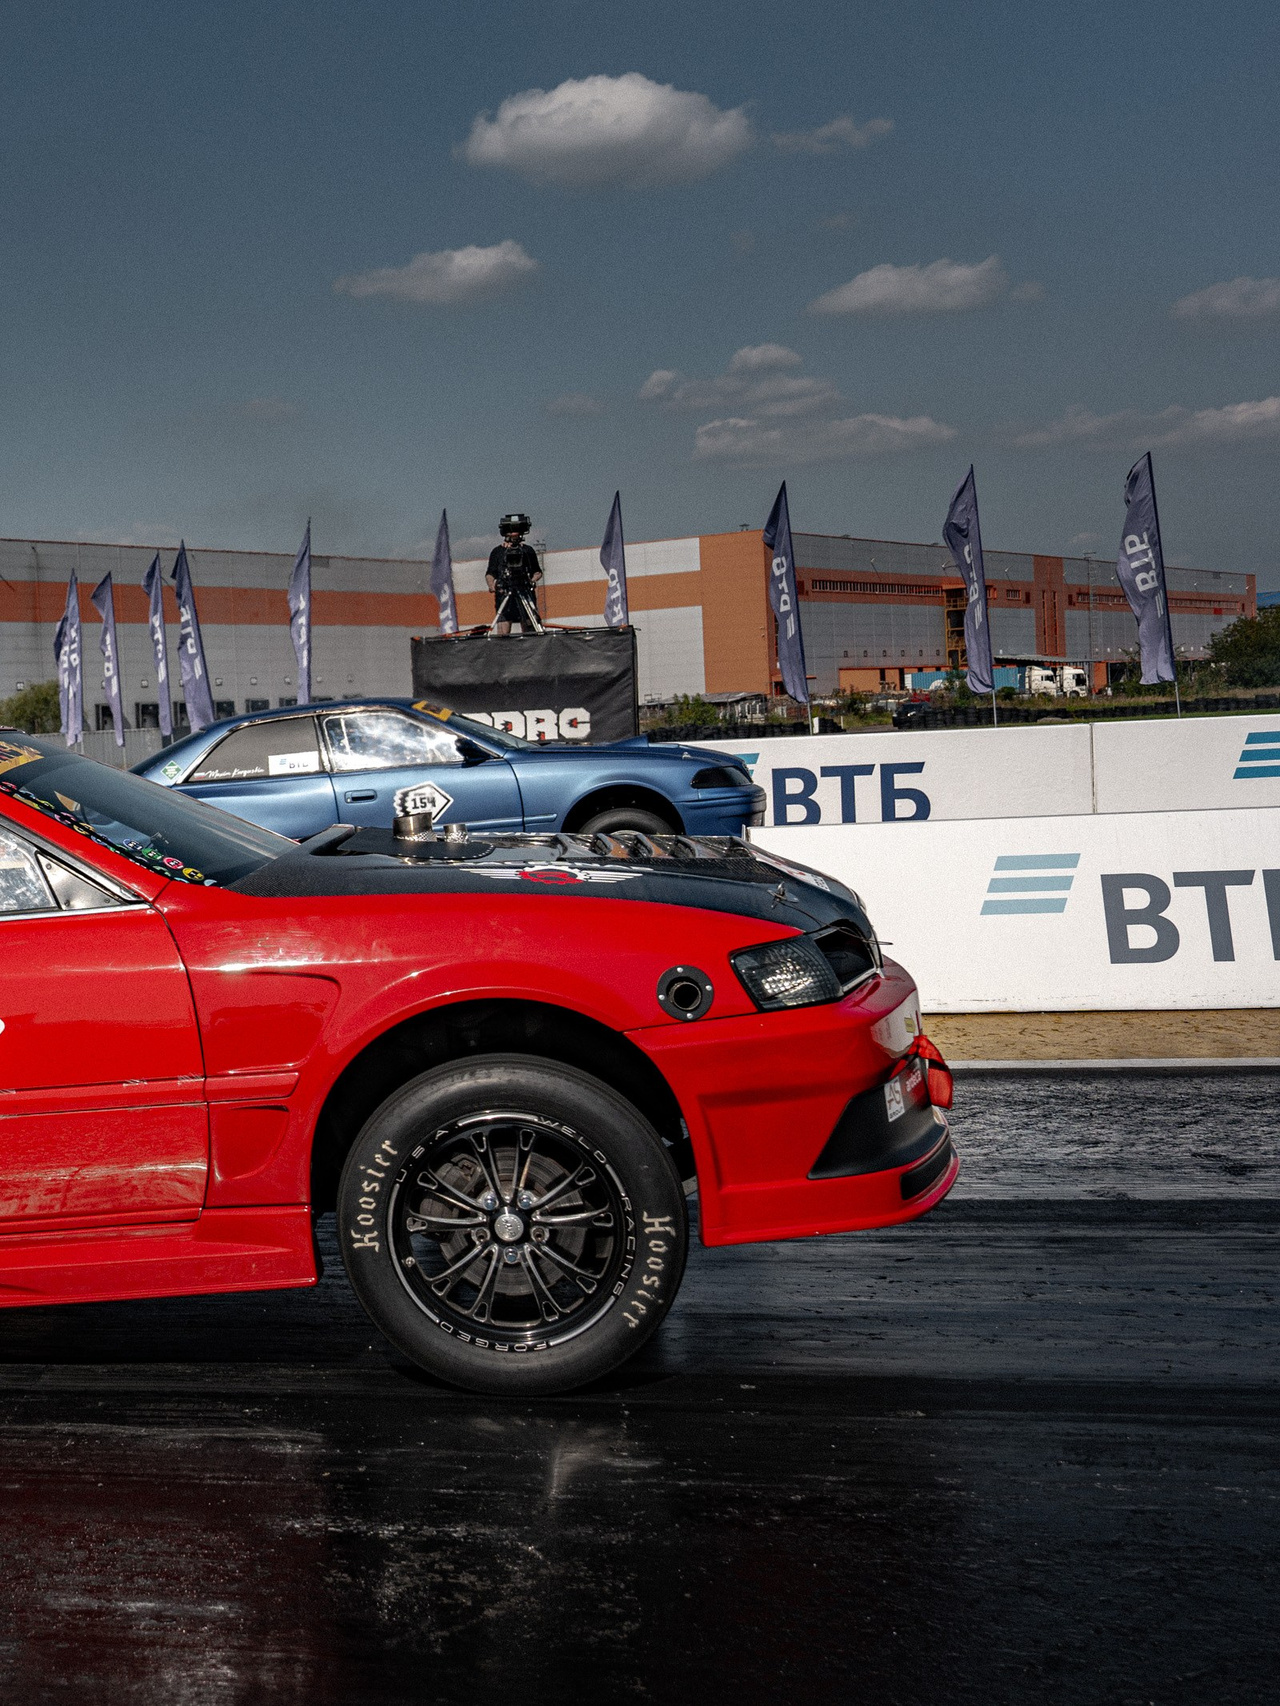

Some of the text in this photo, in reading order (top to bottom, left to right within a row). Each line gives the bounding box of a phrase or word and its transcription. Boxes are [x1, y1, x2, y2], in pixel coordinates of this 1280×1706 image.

[461, 707, 591, 741] DRC
[771, 761, 931, 825] ВТБ
[1100, 869, 1280, 964] ВТ
[539, 1115, 608, 1165] WELD
[350, 1139, 398, 1253] Hoosier
[612, 1196, 637, 1297] RACING
[622, 1210, 677, 1329] Hoosier
[439, 1320, 548, 1352] FORGED
